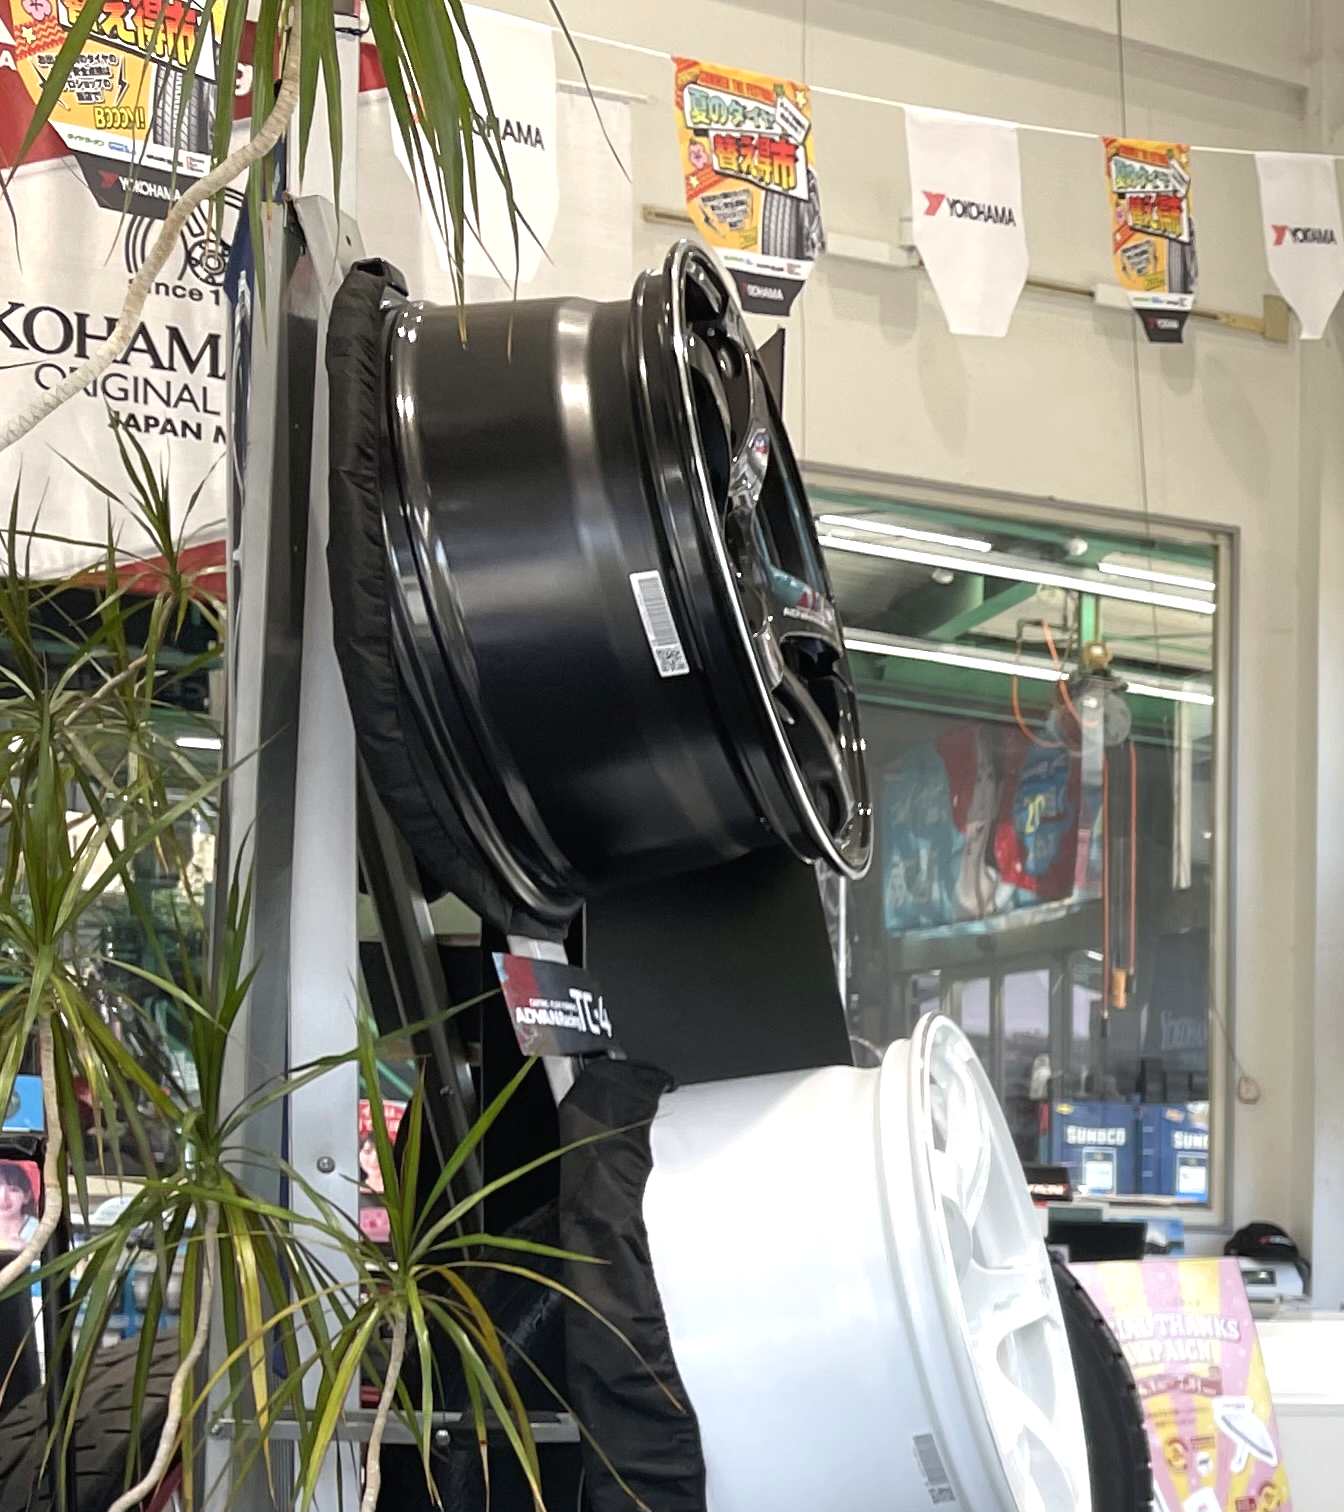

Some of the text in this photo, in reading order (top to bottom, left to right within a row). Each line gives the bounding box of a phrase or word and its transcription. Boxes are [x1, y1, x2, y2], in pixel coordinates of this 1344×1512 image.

[946, 198, 1016, 227] YOKOHAMA
[34, 363, 221, 416] OGINAL
[1066, 1126, 1126, 1145] SUNOCO
